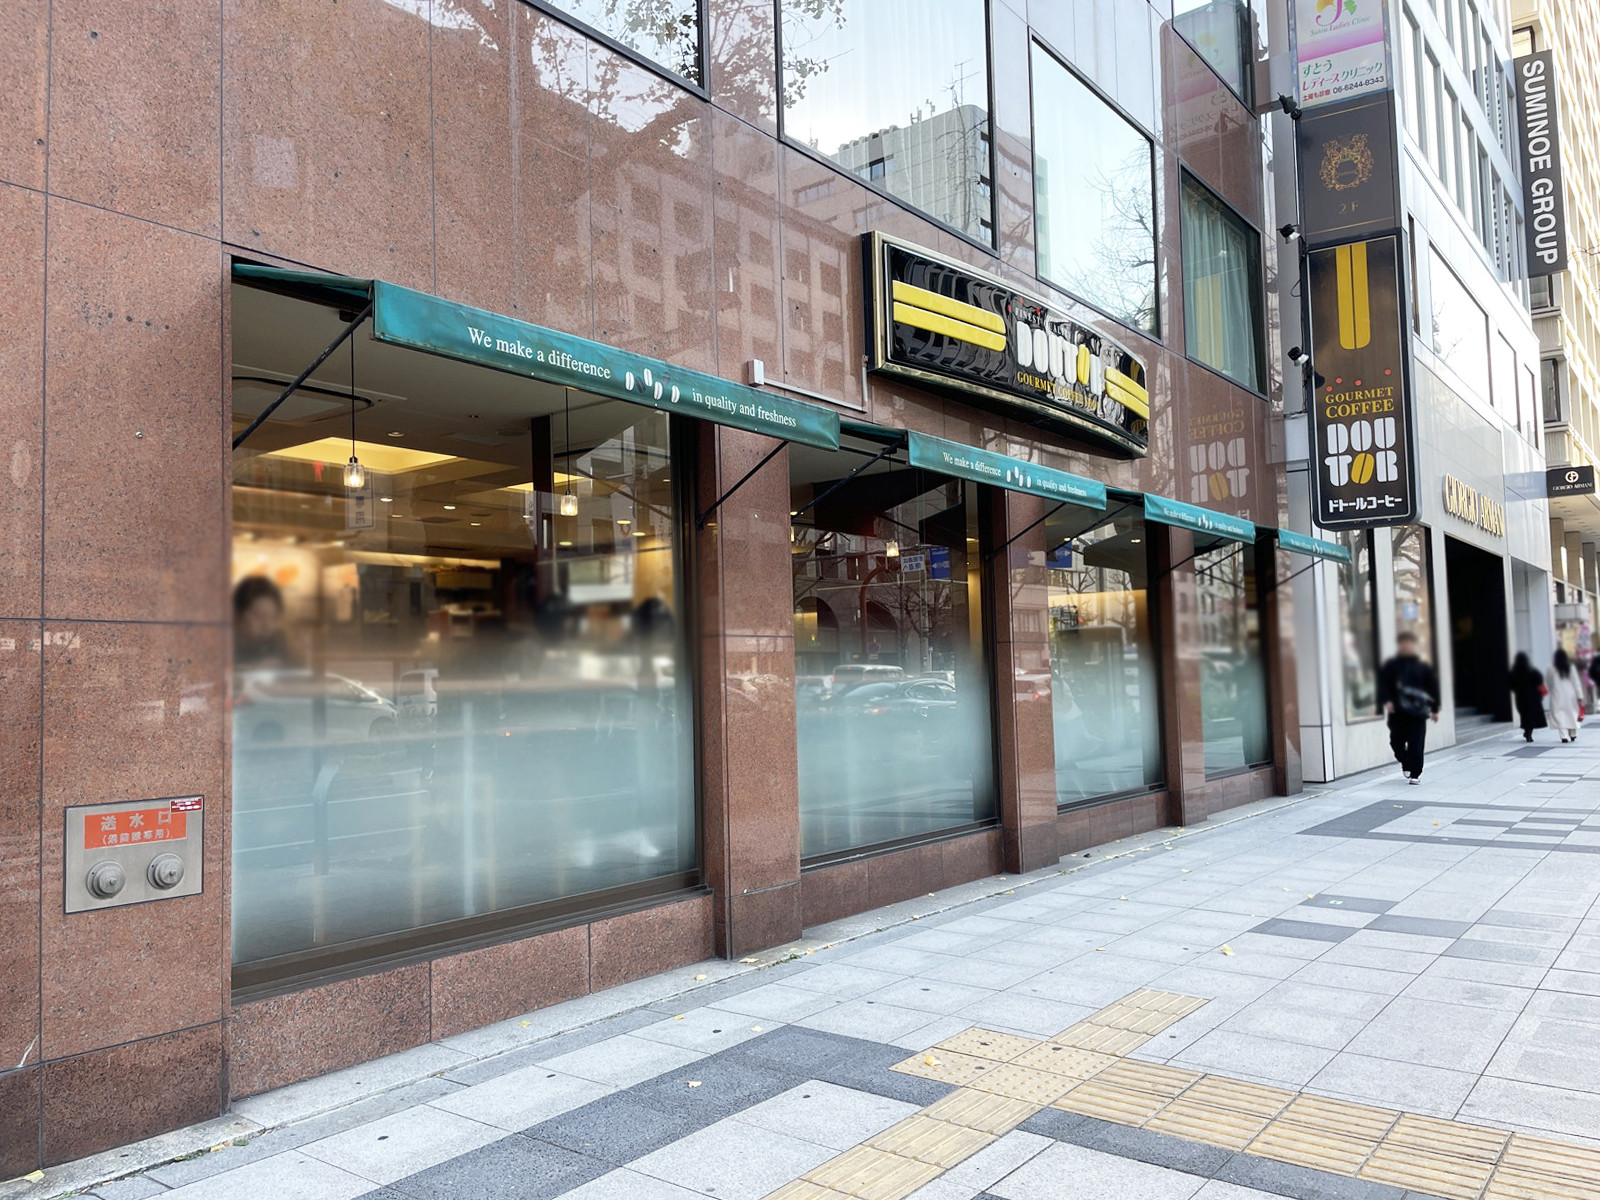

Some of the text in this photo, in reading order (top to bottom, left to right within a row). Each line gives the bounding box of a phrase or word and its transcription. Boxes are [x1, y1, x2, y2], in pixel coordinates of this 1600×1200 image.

[1303, 60, 1333, 77] すとう
[1333, 75, 1384, 94] 06-6244-8343
[1522, 59, 1558, 265] SUMINOE GROUP
[467, 327, 611, 379] We make a difference
[1017, 371, 1056, 393] GOURMET
[1325, 386, 1394, 405] GOURMET
[692, 388, 797, 428] in quality and freshness
[1325, 398, 1395, 419] COFFEE
[943, 451, 953, 464] We
[1328, 494, 1403, 513] ドトールコーヒー
[100, 811, 172, 832] 送水口
